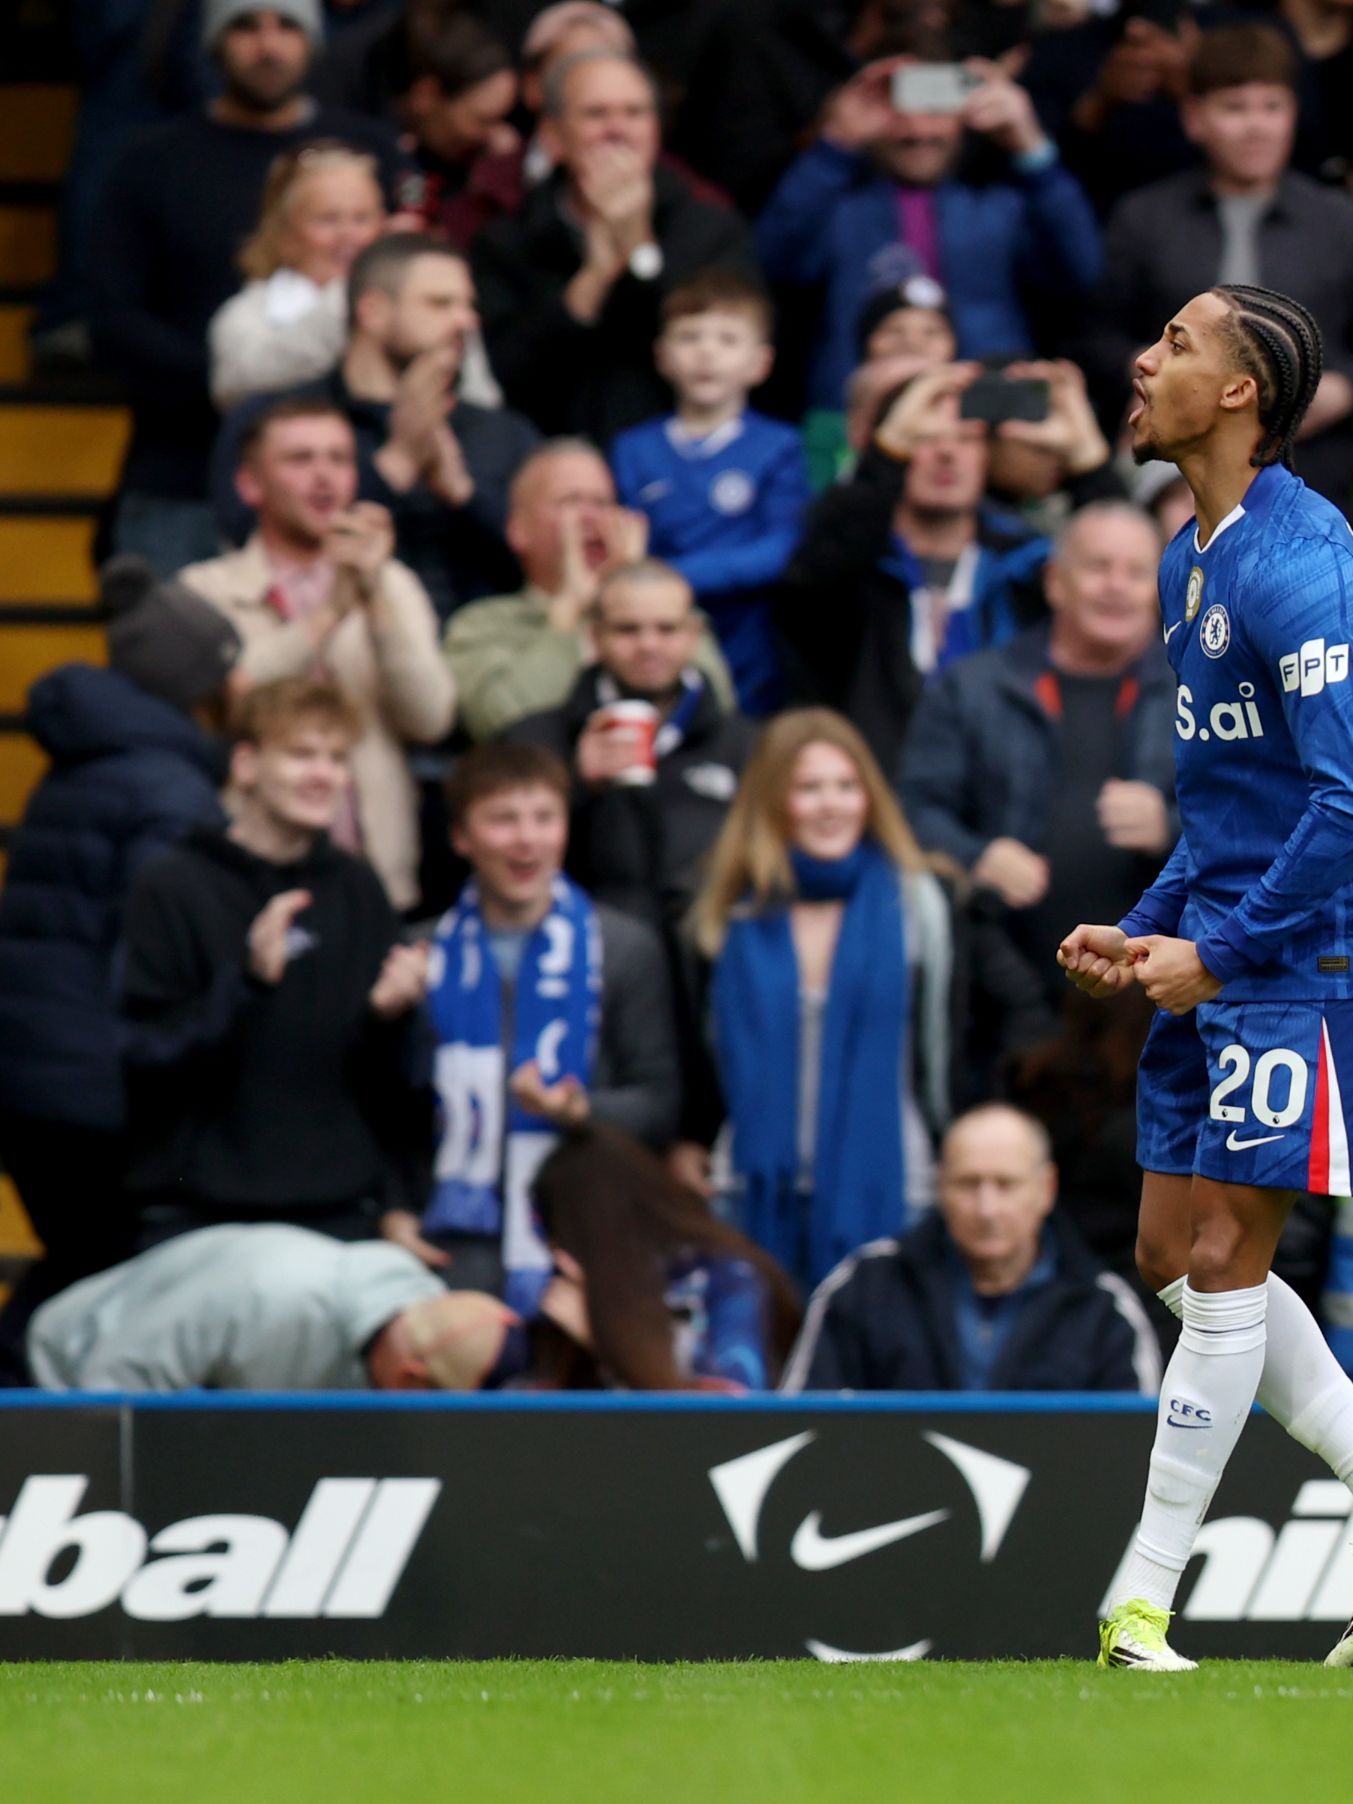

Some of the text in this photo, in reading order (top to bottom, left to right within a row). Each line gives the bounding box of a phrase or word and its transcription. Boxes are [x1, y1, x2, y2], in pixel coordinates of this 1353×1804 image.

[1280, 651, 1347, 687] FPT
[1210, 1044, 1308, 1128] 20
[1170, 1399, 1211, 1421] CFC
[0, 1474, 442, 1621] ball
